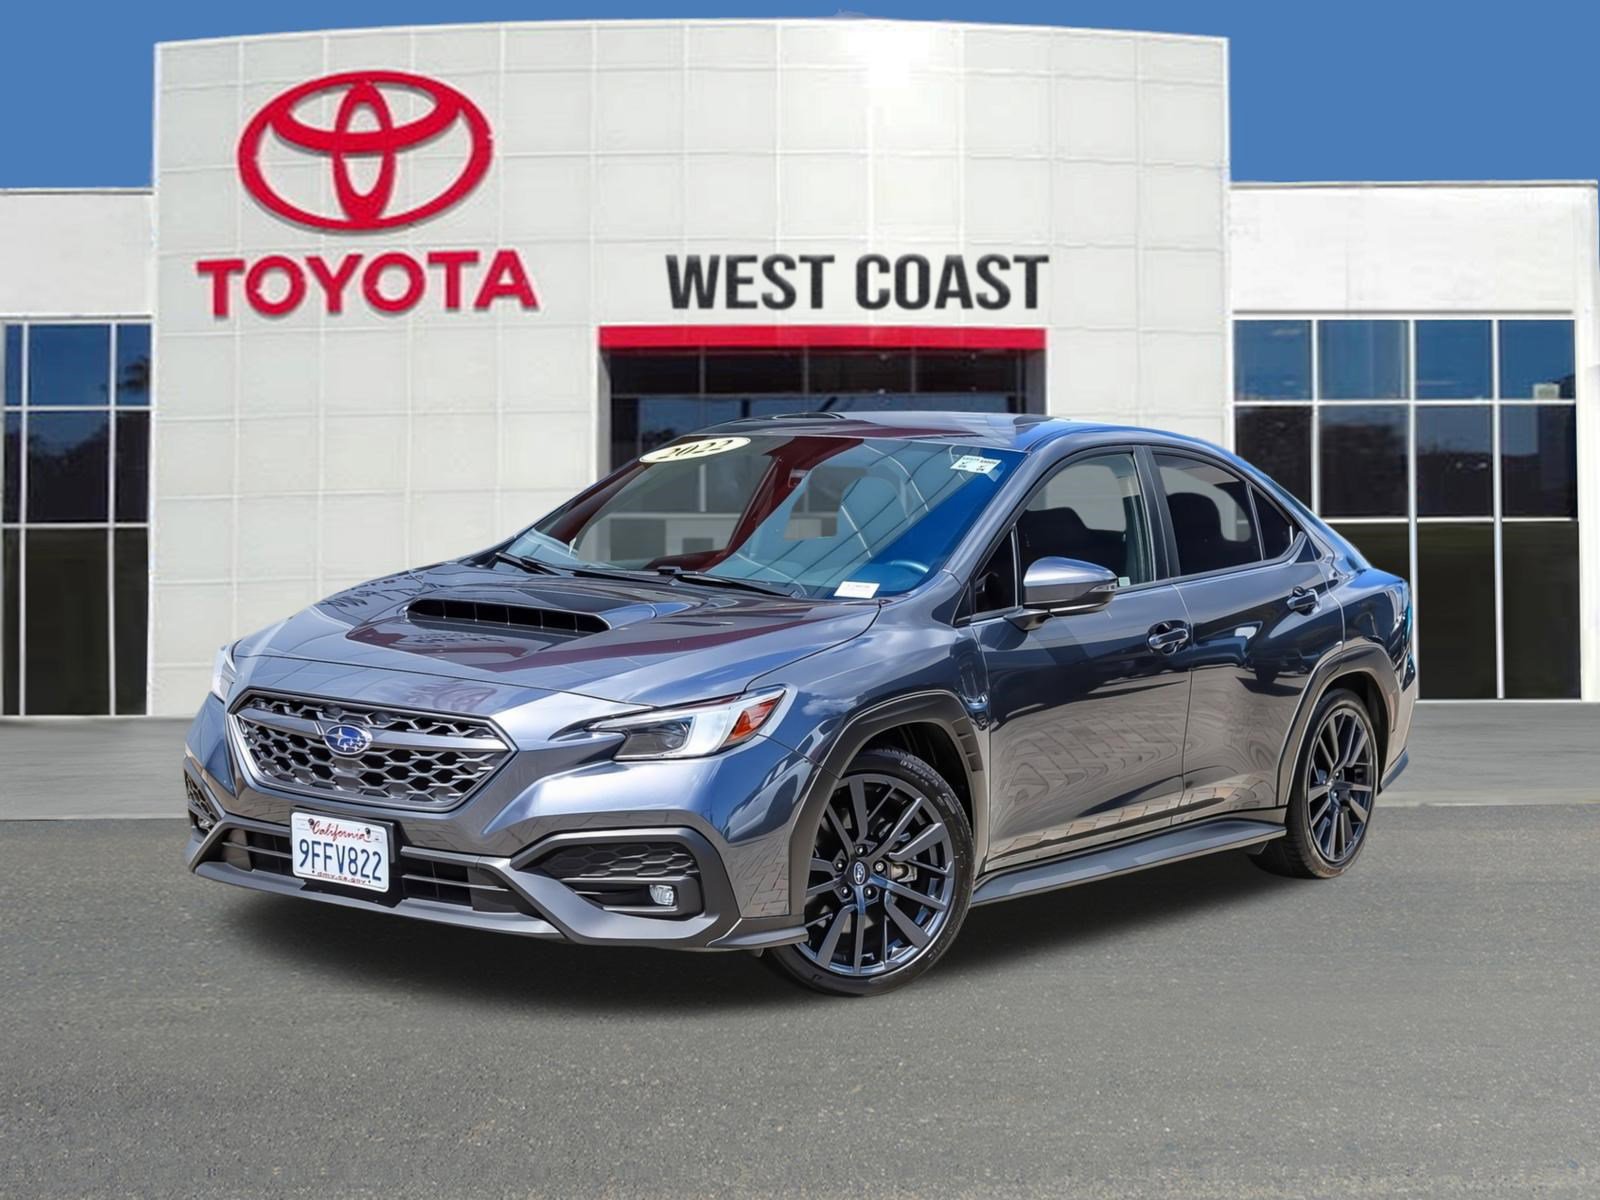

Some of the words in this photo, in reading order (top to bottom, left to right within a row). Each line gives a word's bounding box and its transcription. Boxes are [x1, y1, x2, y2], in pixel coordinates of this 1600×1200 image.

[196, 250, 539, 318] TOYOTA
[665, 254, 835, 310] WEST
[855, 253, 1049, 310] COAST
[656, 440, 734, 460] 2022
[311, 820, 371, 842] California
[299, 838, 382, 881] 9FFV822
